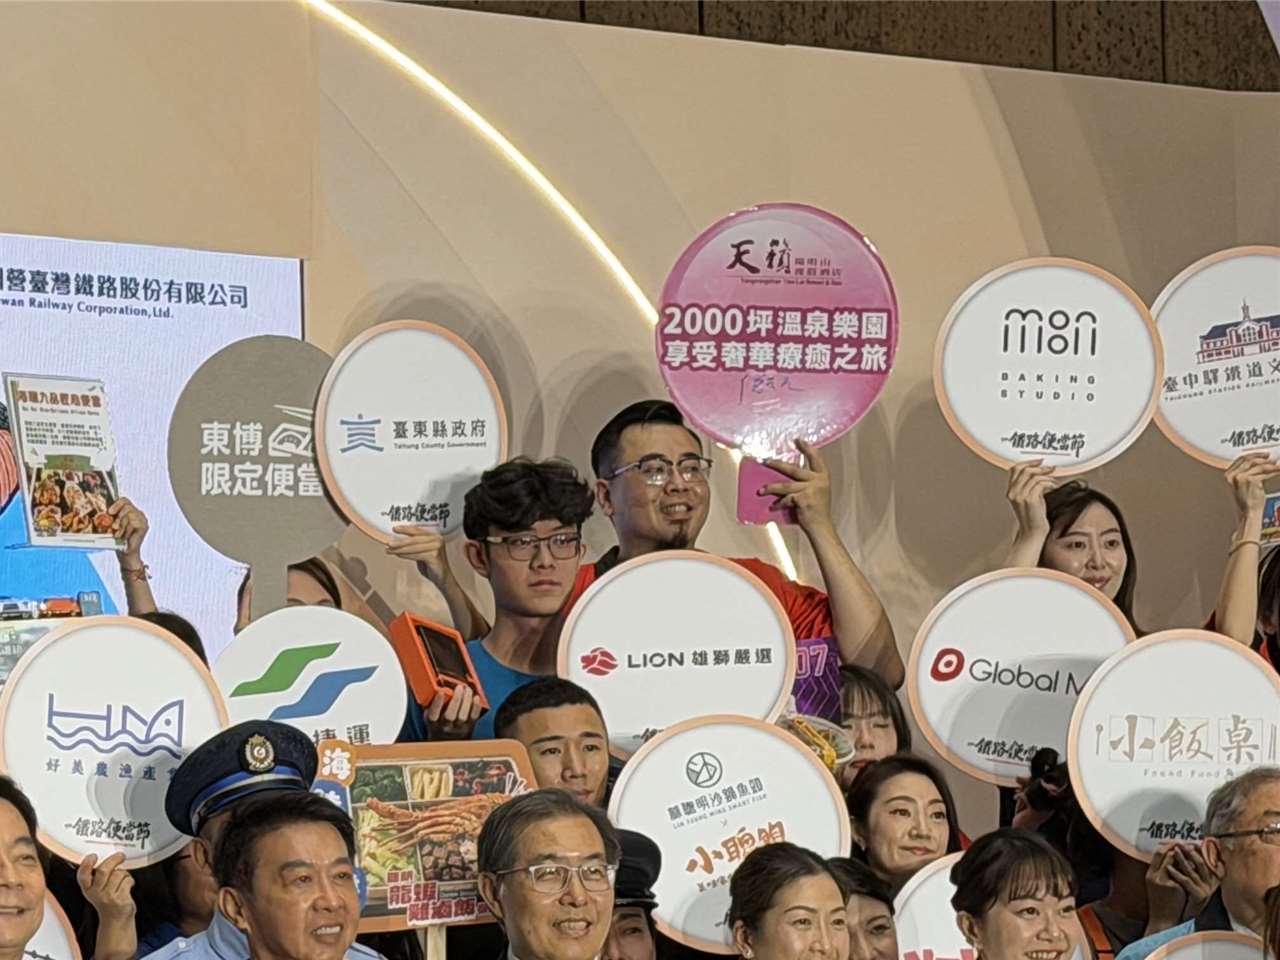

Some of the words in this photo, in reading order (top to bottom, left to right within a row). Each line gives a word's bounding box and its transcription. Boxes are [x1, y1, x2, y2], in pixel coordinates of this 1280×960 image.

[29, 297, 74, 313] Railway
[664, 340, 888, 371] 享受奢華療癒之旅
[1001, 372, 1095, 385] BAKING
[1000, 389, 1095, 402] STUDIO
[200, 421, 264, 457] 東博
[392, 418, 488, 439] 臺東縣政府
[200, 462, 324, 497] 限定便當
[627, 652, 684, 669] LION
[691, 648, 773, 666] 雄獅嚴選
[969, 659, 1060, 693] Global
[1109, 714, 1260, 765] 小飯桌
